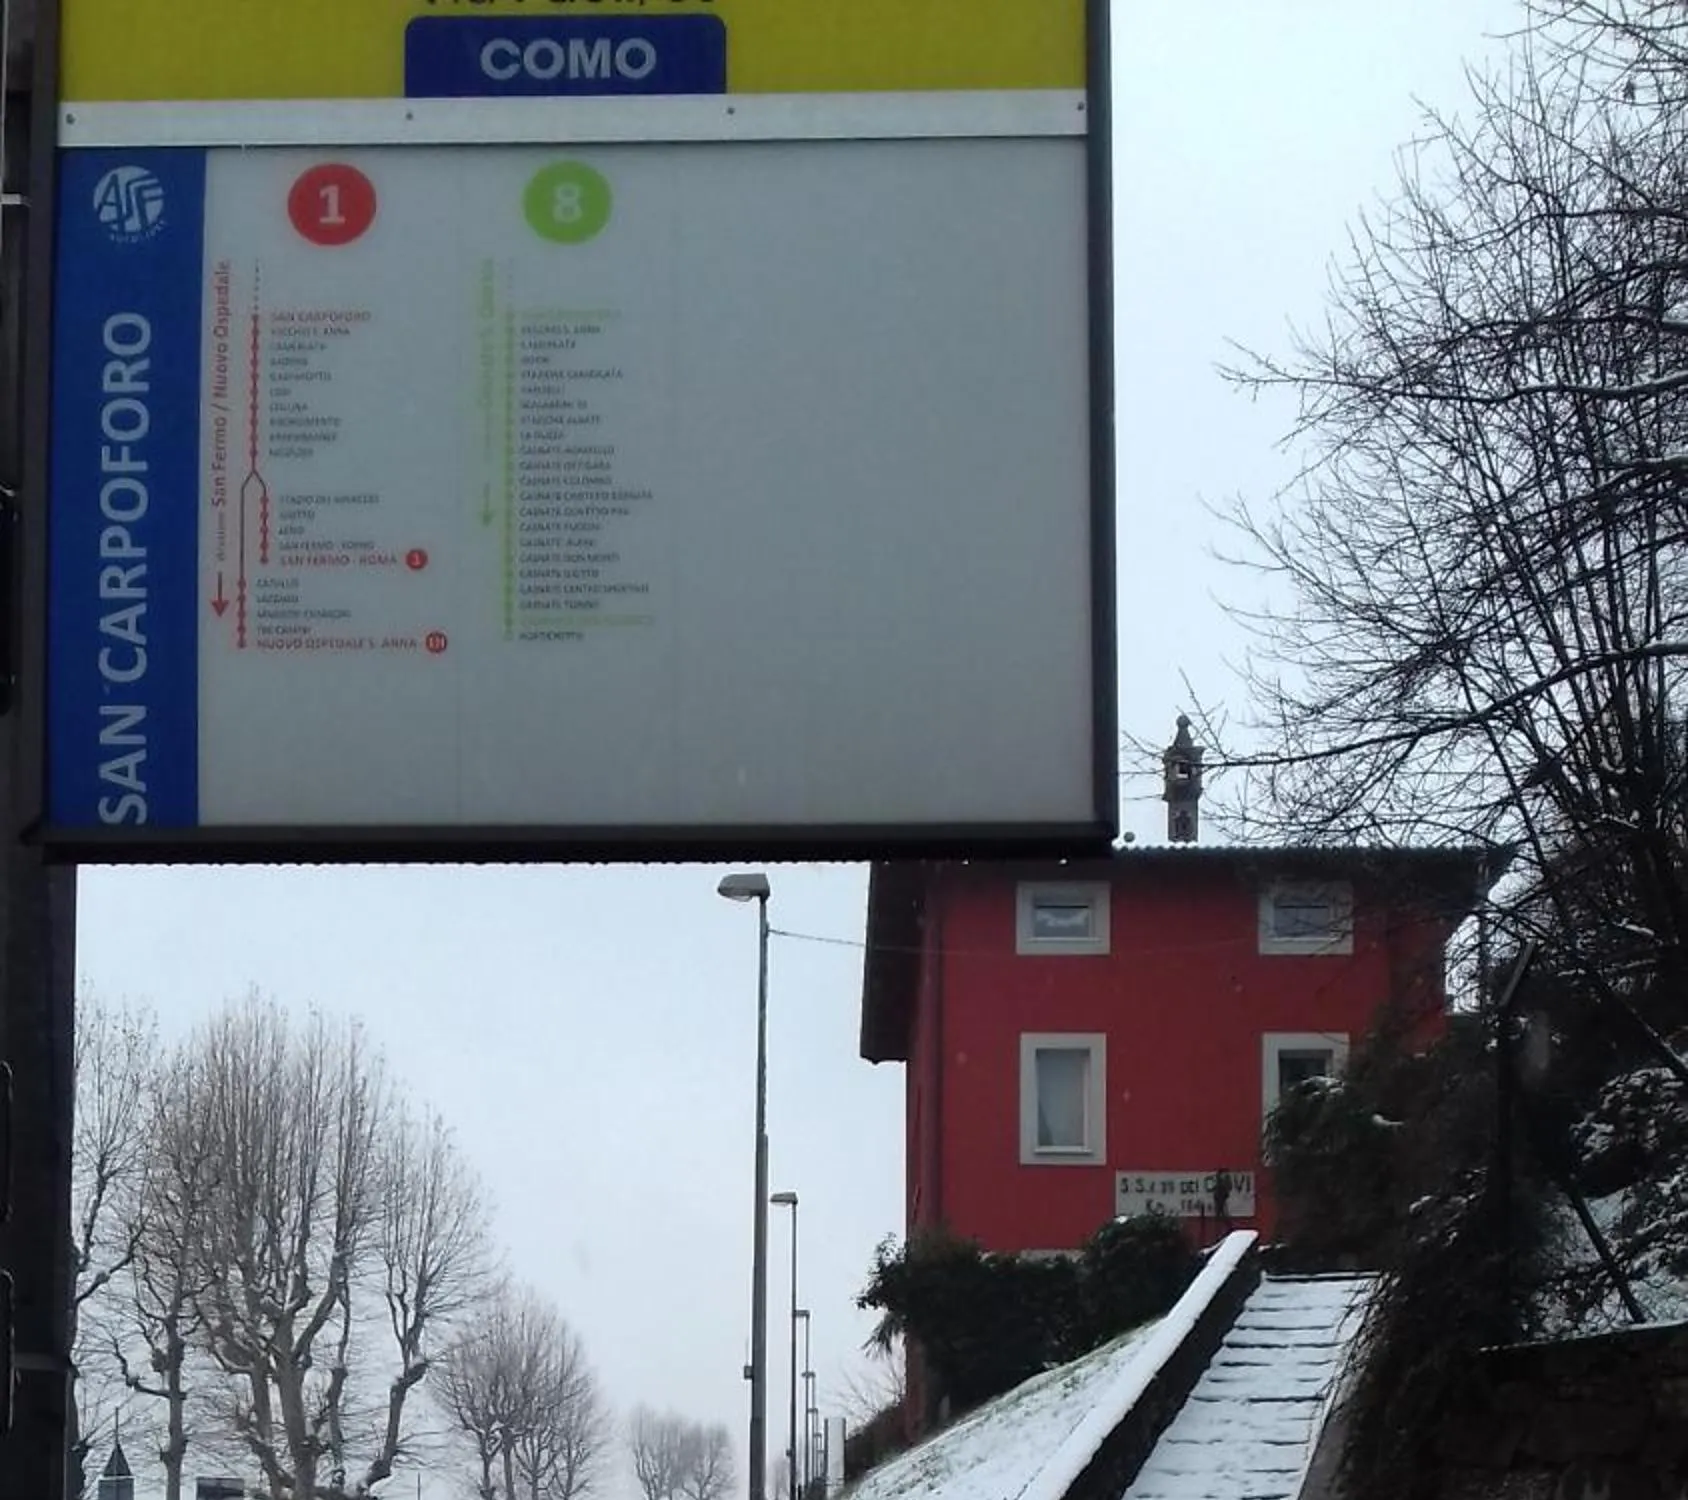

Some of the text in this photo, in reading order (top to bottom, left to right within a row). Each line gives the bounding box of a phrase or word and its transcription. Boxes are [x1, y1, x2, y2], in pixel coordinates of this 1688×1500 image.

[480, 37, 656, 80] COMO
[318, 185, 345, 224] 1
[552, 184, 583, 224] 8
[213, 260, 232, 338] Ospedale
[212, 343, 229, 399] Nuovo
[210, 417, 227, 471] Fermo
[211, 477, 227, 507] San
[99, 312, 152, 825] SAN CARPOFORO
